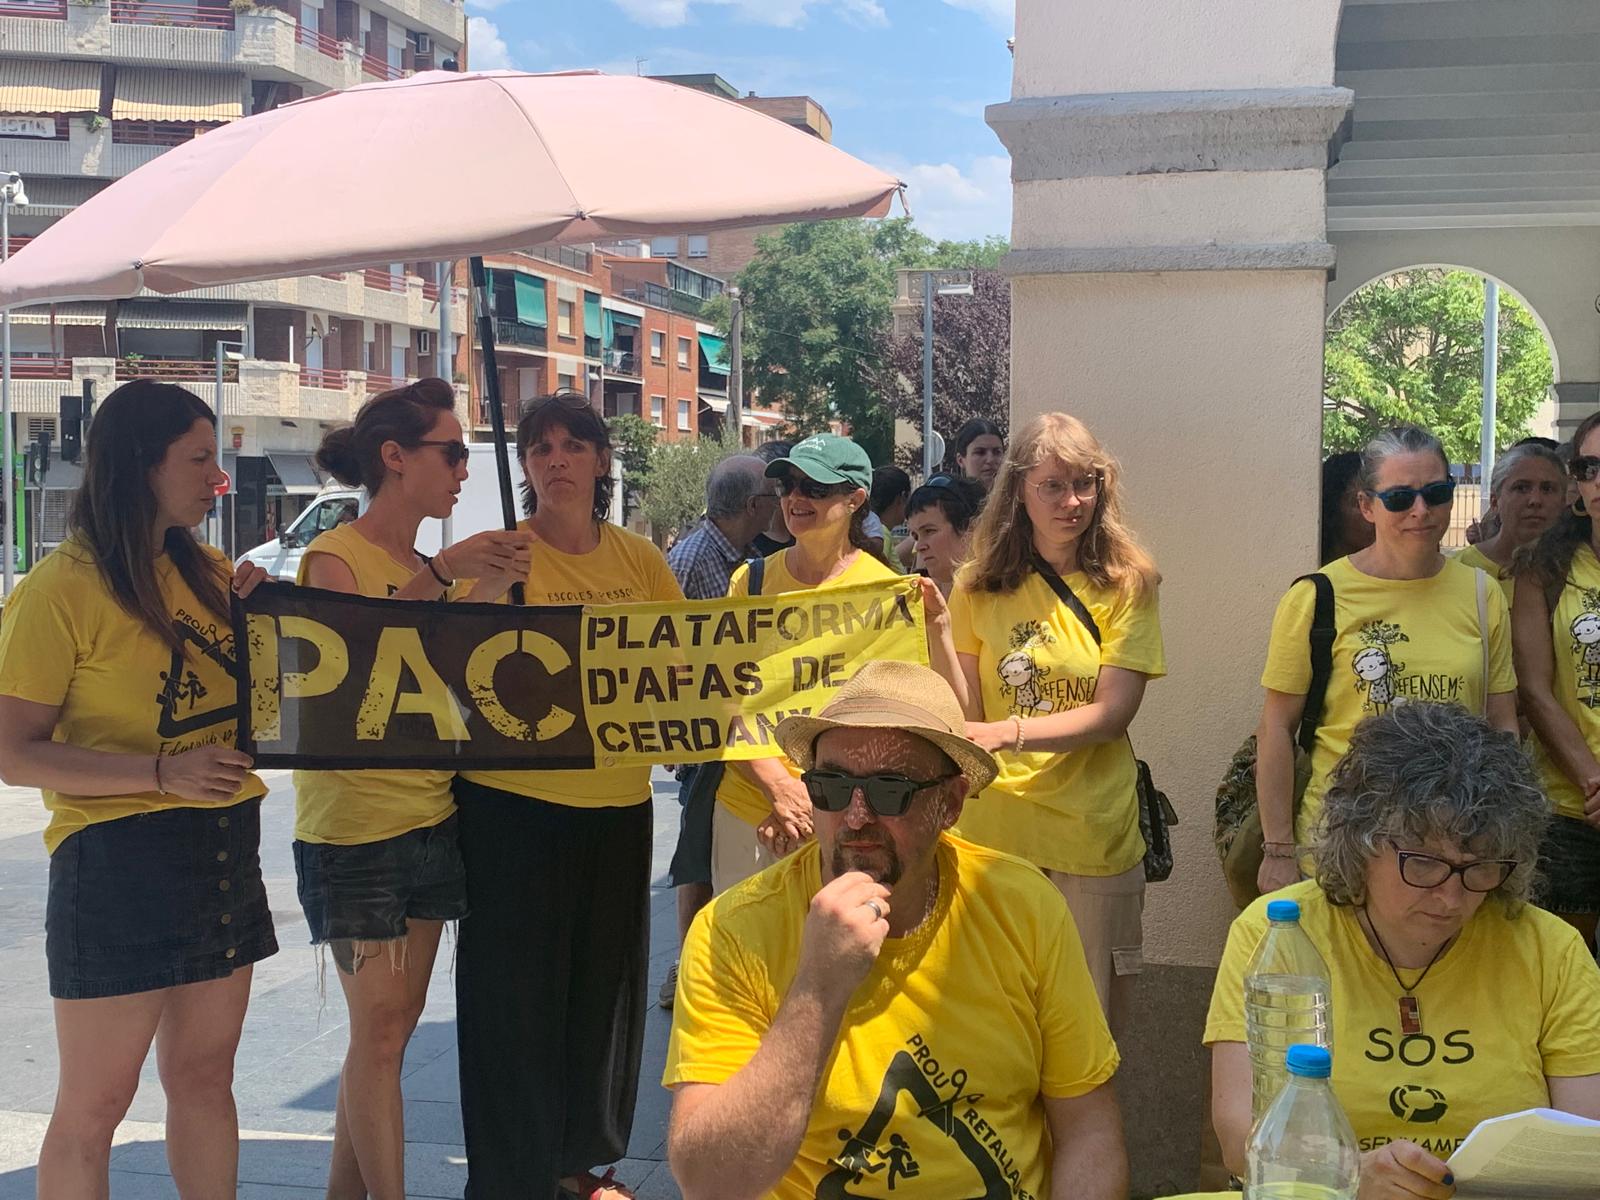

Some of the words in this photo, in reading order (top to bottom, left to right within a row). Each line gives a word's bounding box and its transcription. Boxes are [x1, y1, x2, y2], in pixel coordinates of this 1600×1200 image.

[175, 608, 209, 636] PROU
[587, 593, 915, 650] PLATAFORMA
[246, 613, 577, 741] PAC
[588, 661, 763, 706] D'AFAS
[792, 652, 848, 691] DE
[1040, 676, 1098, 703] DEFENSE
[906, 1033, 949, 1089] PROU
[1365, 1027, 1474, 1066] SOS
